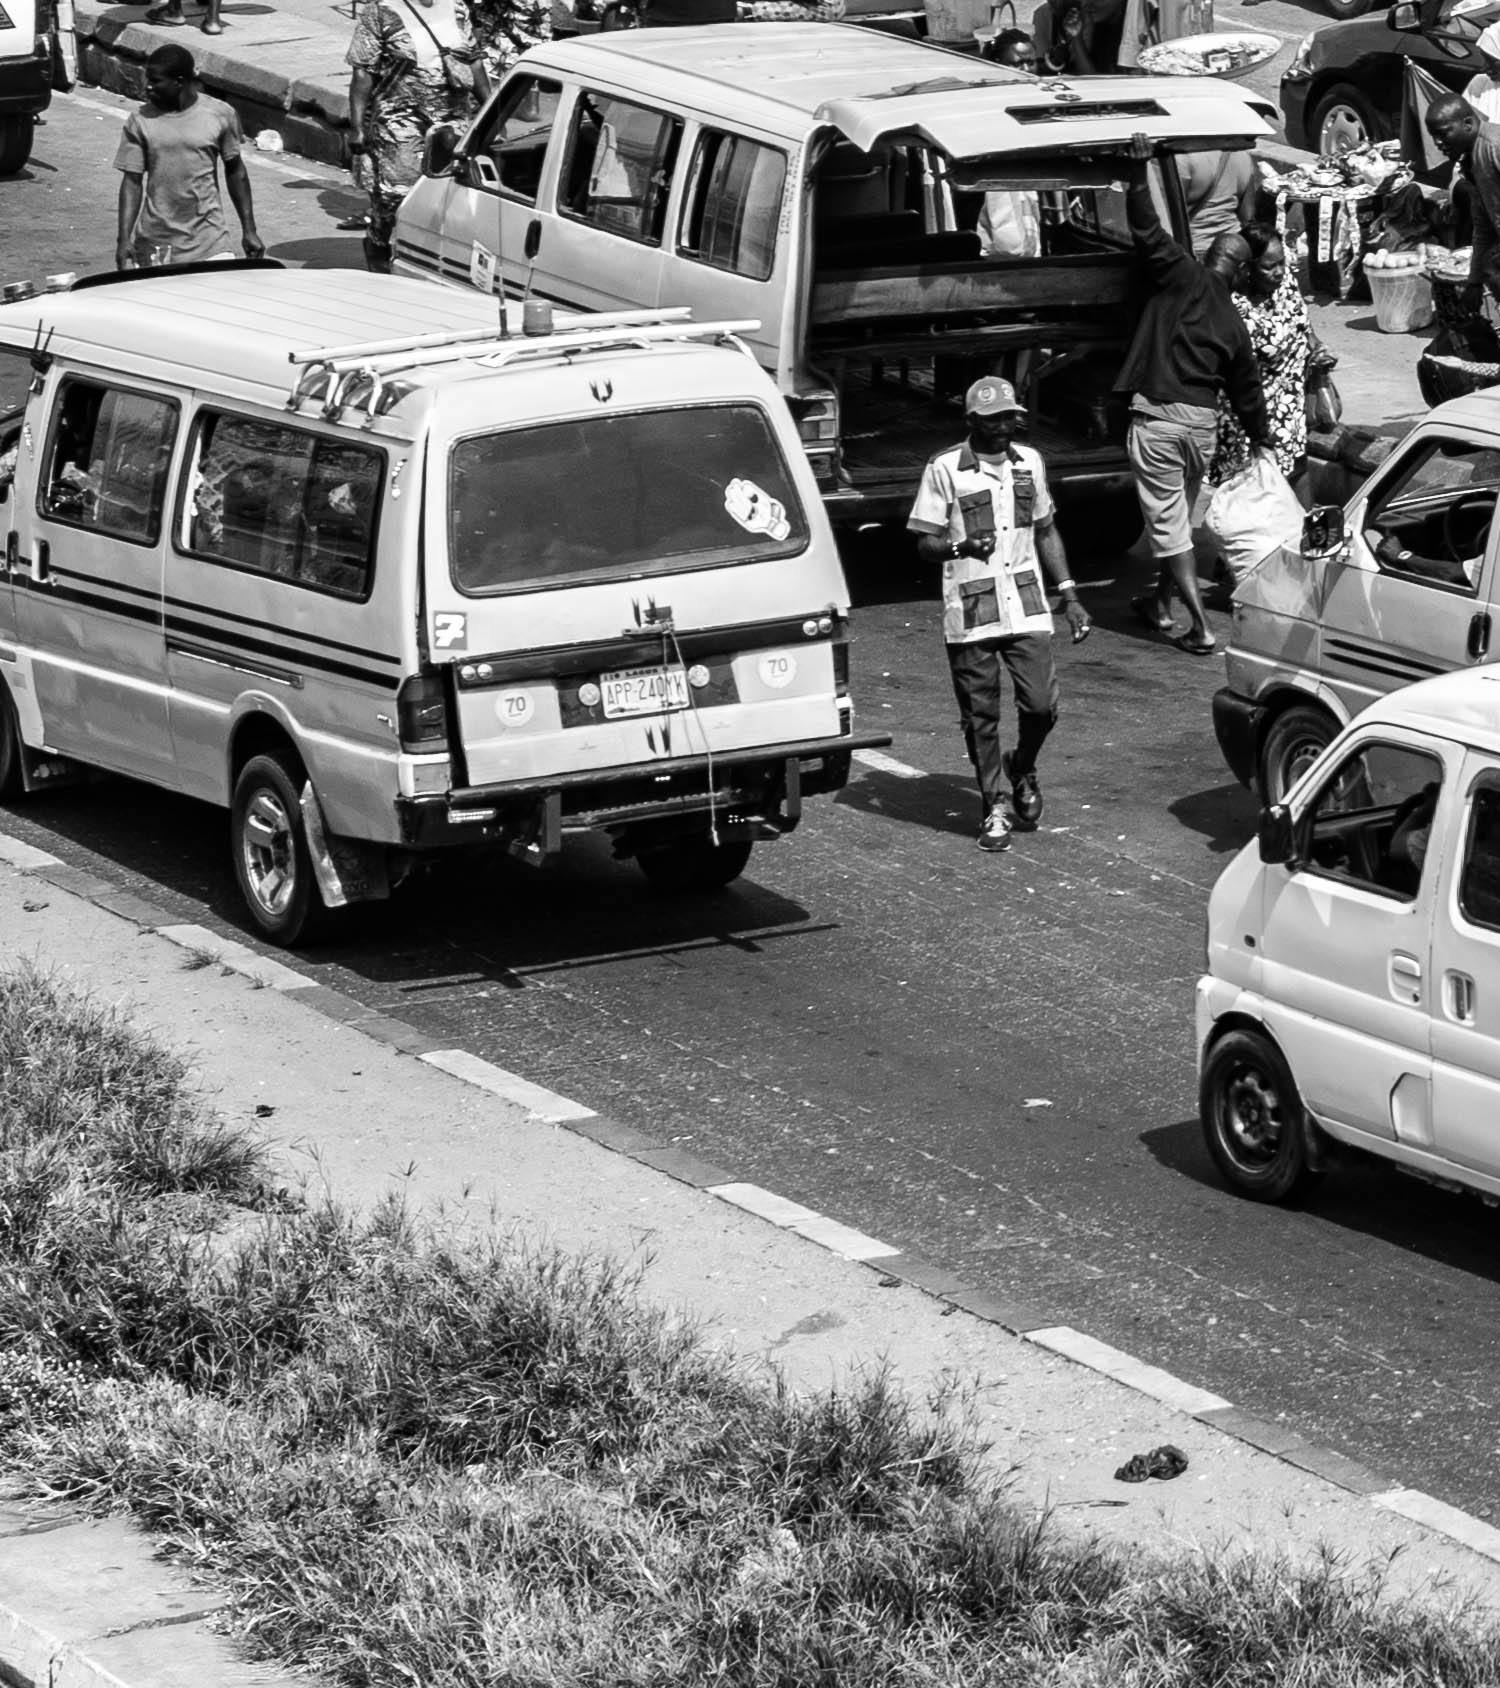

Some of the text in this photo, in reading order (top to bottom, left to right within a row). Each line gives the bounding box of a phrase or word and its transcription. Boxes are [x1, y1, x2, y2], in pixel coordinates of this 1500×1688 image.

[434, 614, 464, 645] 7
[768, 657, 788, 673] 70
[506, 697, 526, 712] 70
